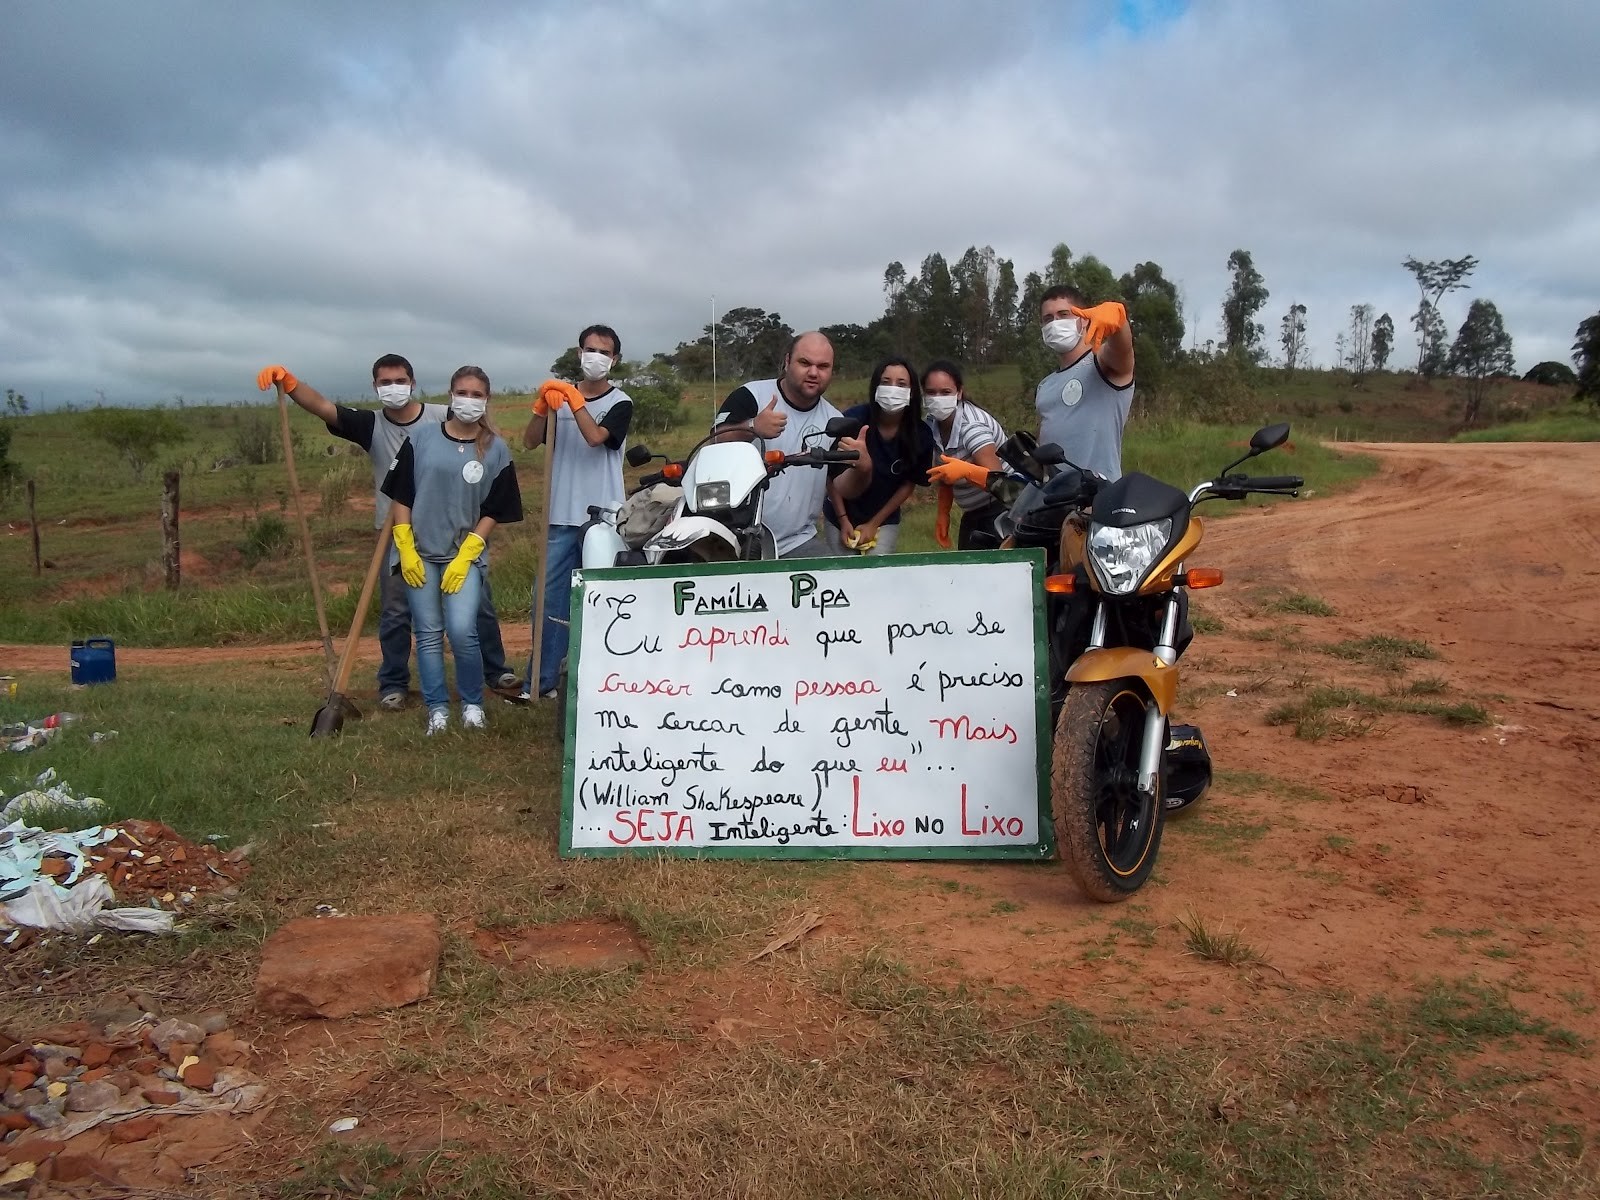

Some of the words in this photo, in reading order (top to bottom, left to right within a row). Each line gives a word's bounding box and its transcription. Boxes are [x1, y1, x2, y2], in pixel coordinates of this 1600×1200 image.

[678, 620, 790, 663] aprendi
[816, 629, 862, 658] que
[887, 620, 953, 655] para
[711, 678, 782, 699] como
[795, 679, 882, 705] pessoa
[906, 661, 927, 692] é
[938, 662, 1024, 703] preciso
[657, 711, 746, 736] cercar
[772, 708, 806, 734] de
[588, 742, 725, 787] inteligente
[751, 746, 785, 774] do
[810, 758, 863, 788] que
[915, 814, 944, 835] NO
